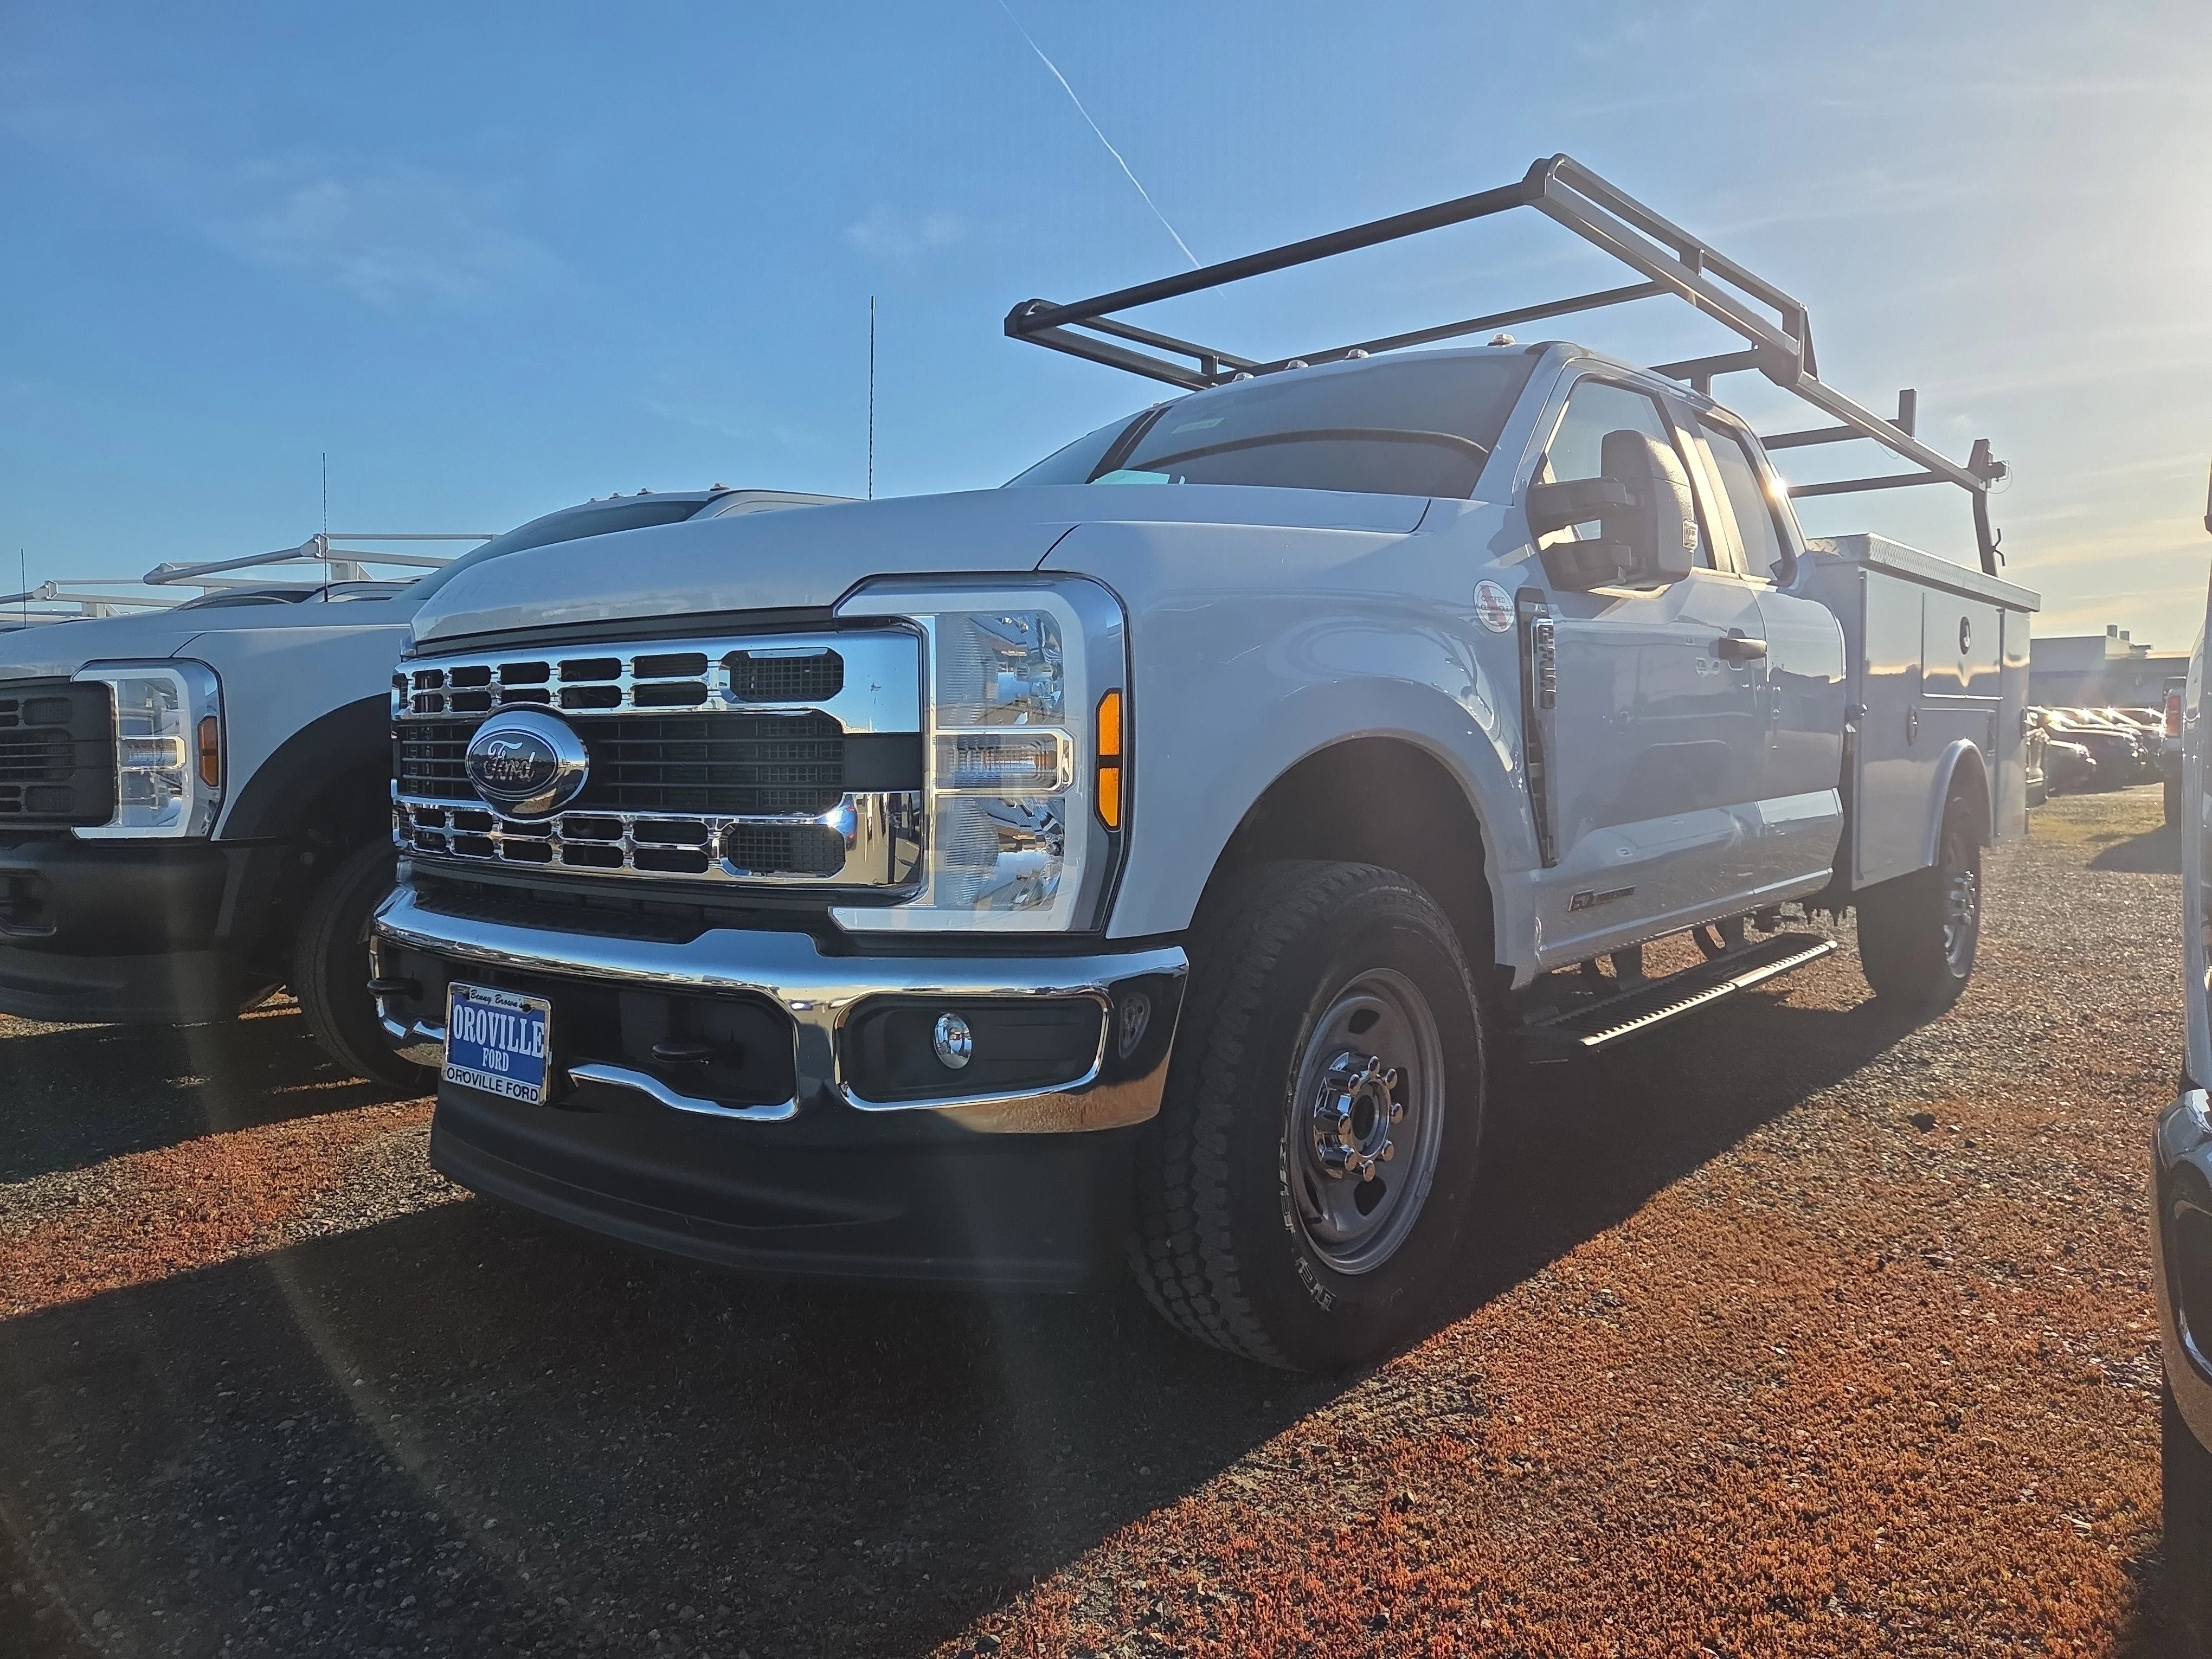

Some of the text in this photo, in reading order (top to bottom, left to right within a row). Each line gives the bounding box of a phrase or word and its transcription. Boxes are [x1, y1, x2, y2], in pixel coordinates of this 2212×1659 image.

[1534, 603, 1546, 613] XL
[484, 740, 536, 782] Ford
[470, 989, 492, 1004] Benny
[453, 1004, 545, 1059] OROVILLE
[481, 1047, 510, 1072] FORD
[446, 1066, 538, 1102] OROVILLE FORD
